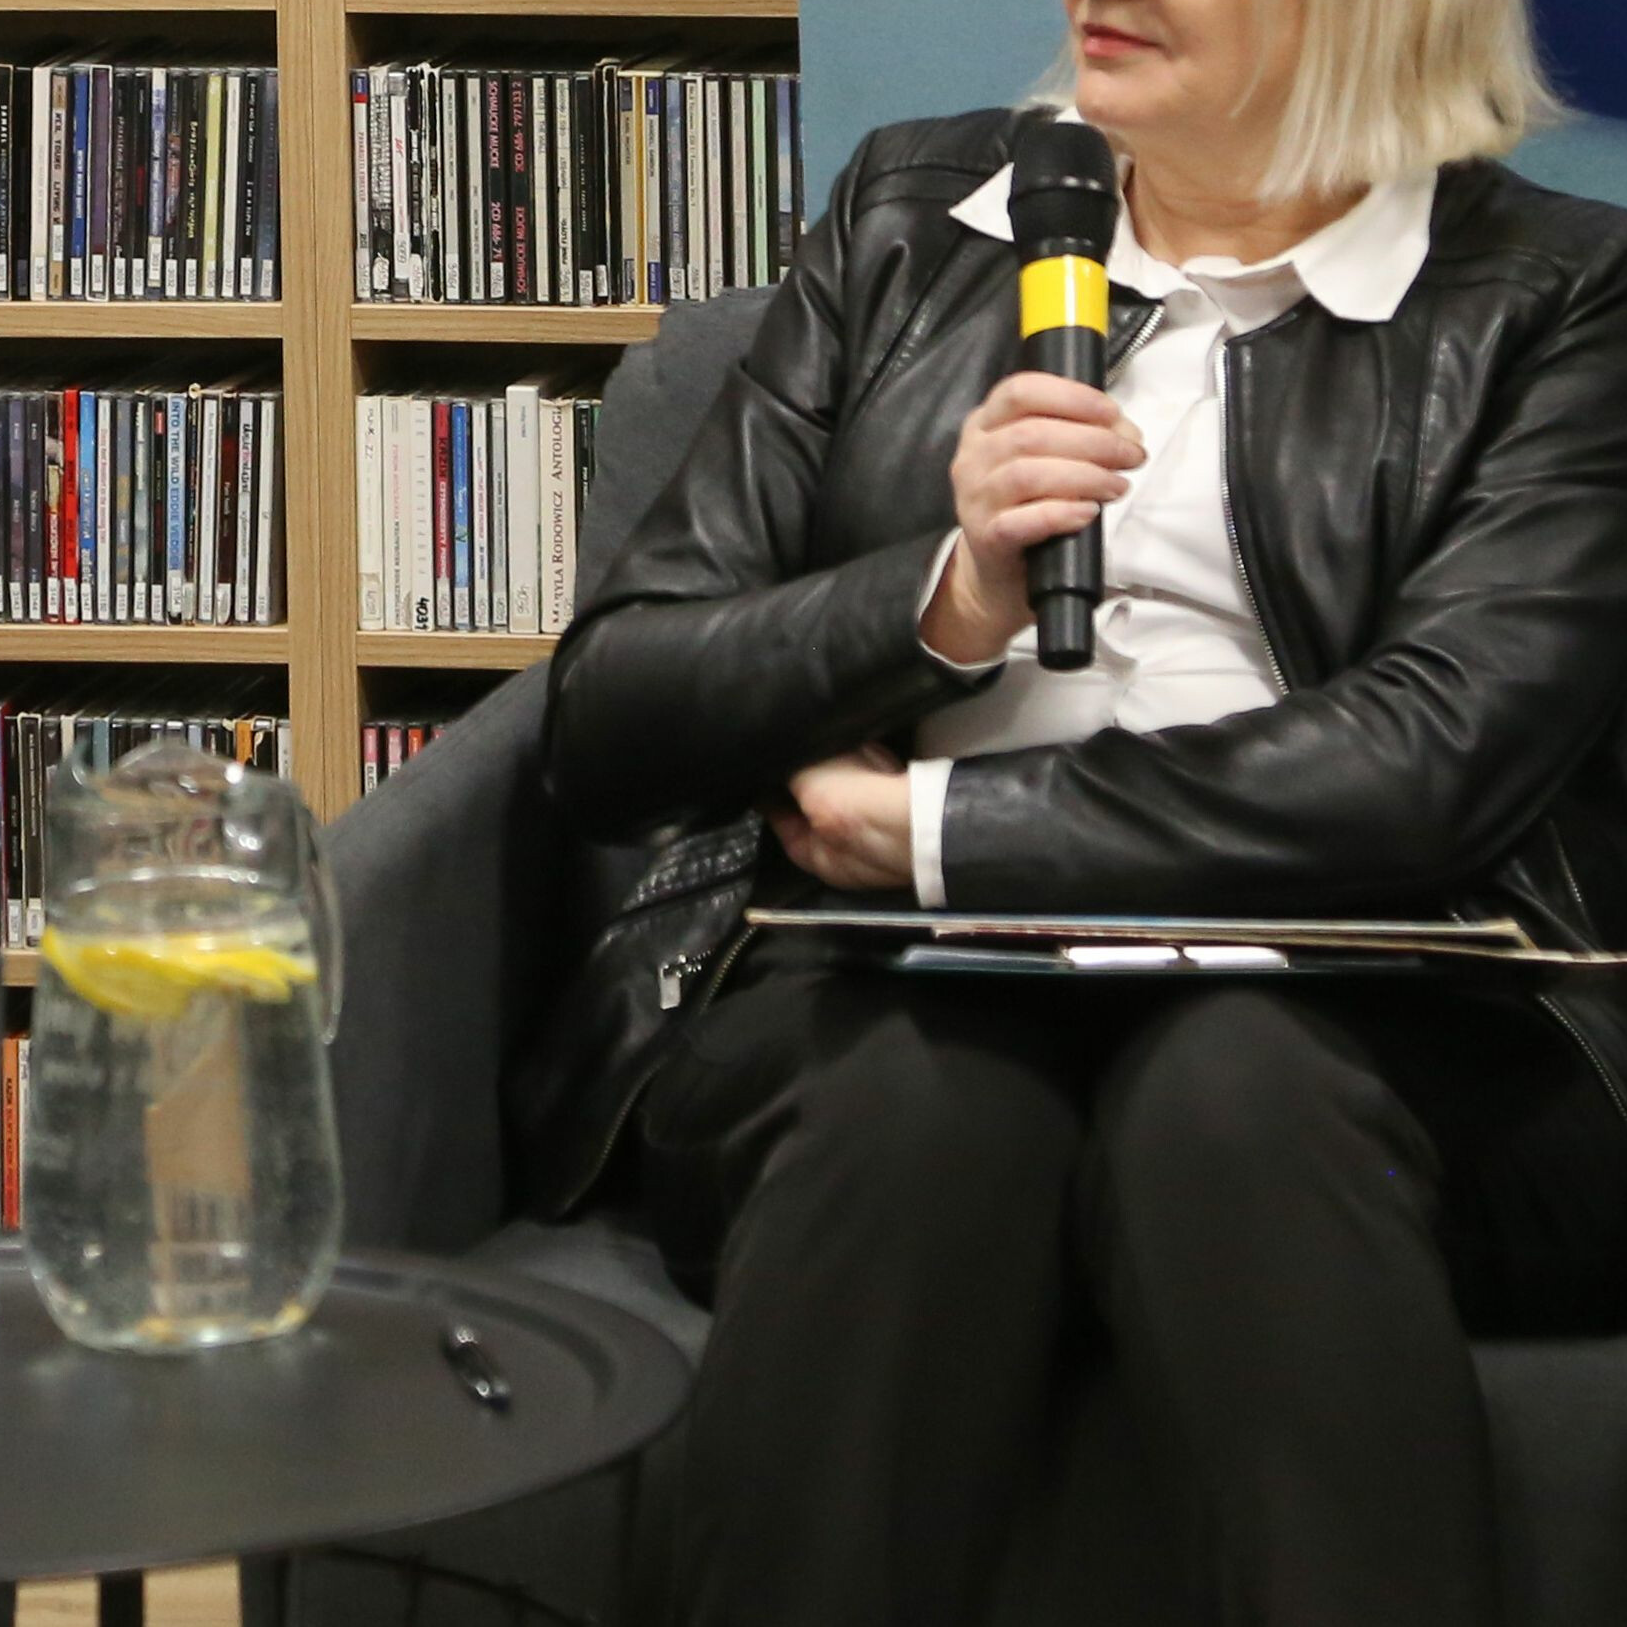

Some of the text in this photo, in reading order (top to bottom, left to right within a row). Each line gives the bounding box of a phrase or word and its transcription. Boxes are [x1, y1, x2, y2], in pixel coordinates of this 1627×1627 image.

[489, 81, 500, 133] SCHMUCKE
[490, 135, 500, 169] MUCKE
[490, 202, 501, 220] 2CD
[170, 401, 180, 570] INTO THE WILD EDDIE VEDDER
[551, 491, 563, 564] RODOWICZ
